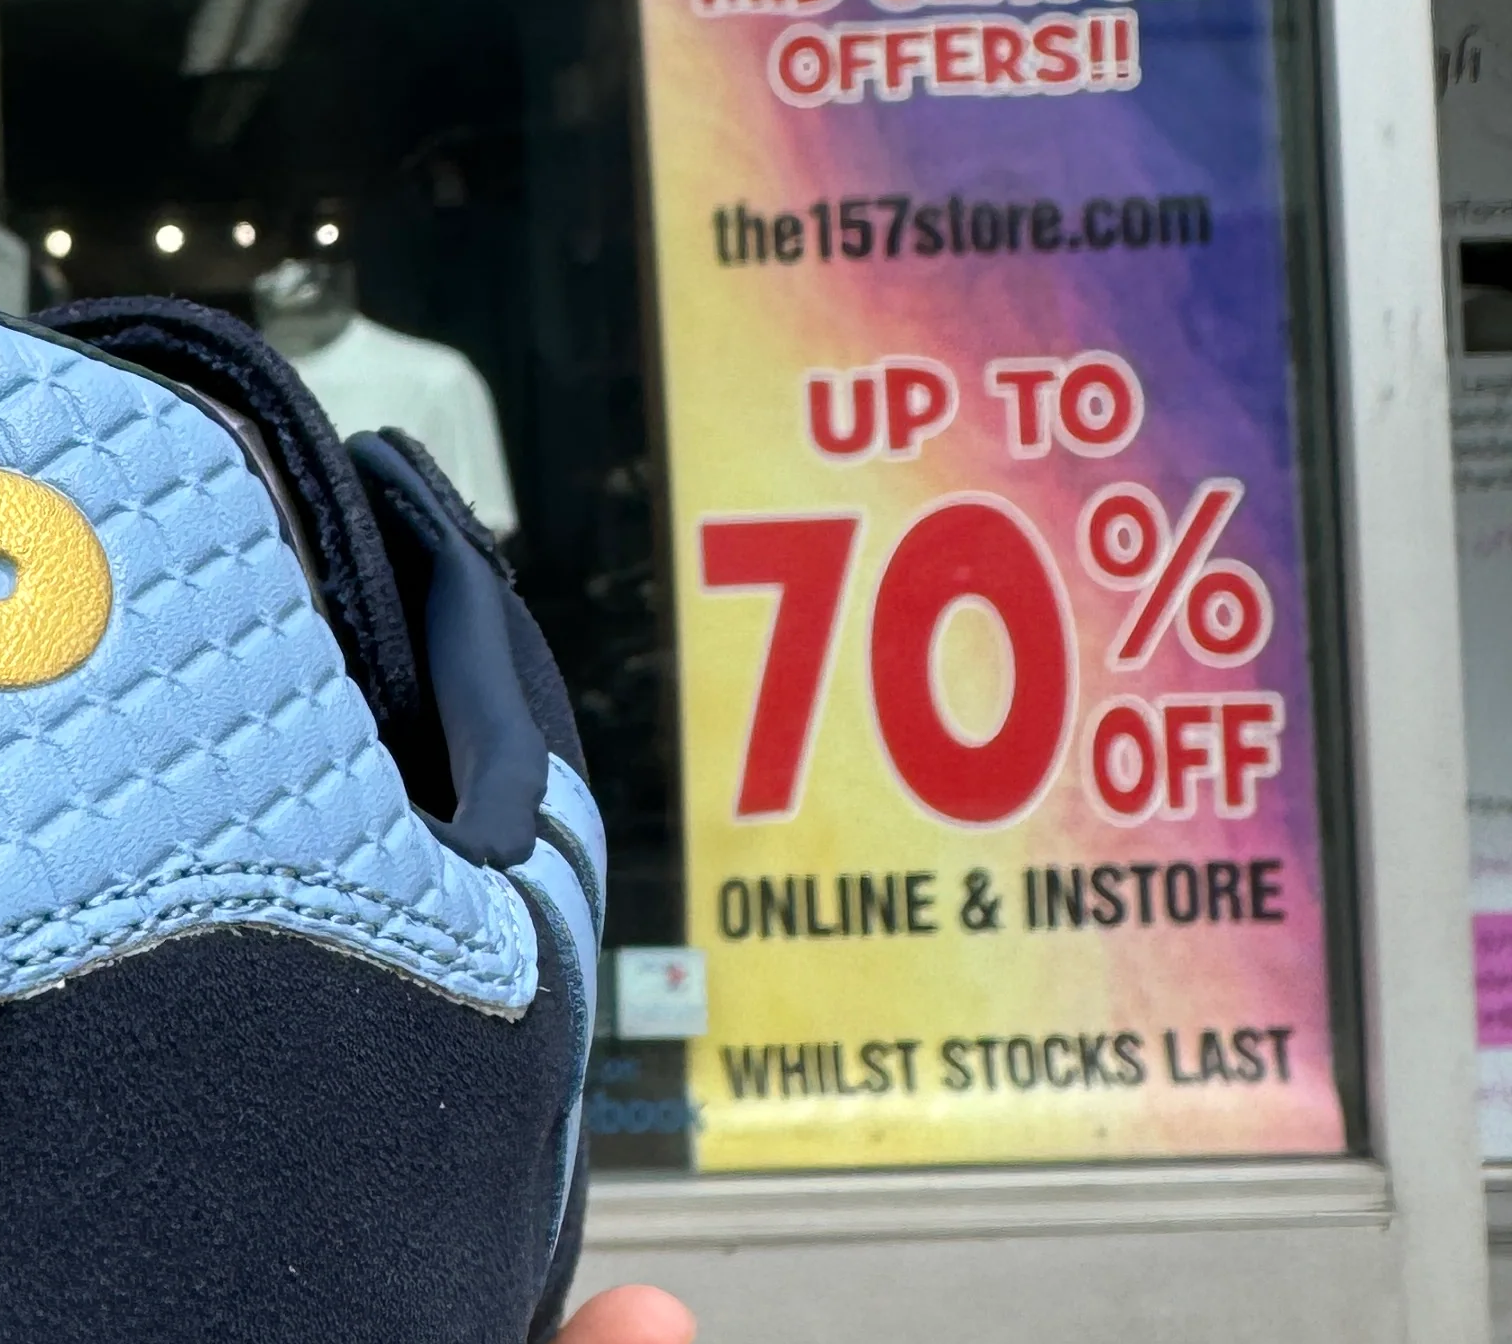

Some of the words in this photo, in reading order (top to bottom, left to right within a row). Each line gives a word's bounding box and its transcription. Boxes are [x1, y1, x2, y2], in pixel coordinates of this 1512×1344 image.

[770, 9, 1141, 107] OFFERS!!
[713, 194, 1211, 267] the157store.com
[807, 357, 958, 467] UP
[987, 350, 1144, 459] TO
[1083, 690, 1285, 828] OFF
[718, 870, 937, 942] ONLINE
[959, 868, 1002, 933] &
[1026, 861, 1286, 932] INSTORE
[721, 1041, 919, 1102] WHILST
[940, 1034, 1146, 1092] STOCKS
[1167, 1028, 1293, 1085] LAST
